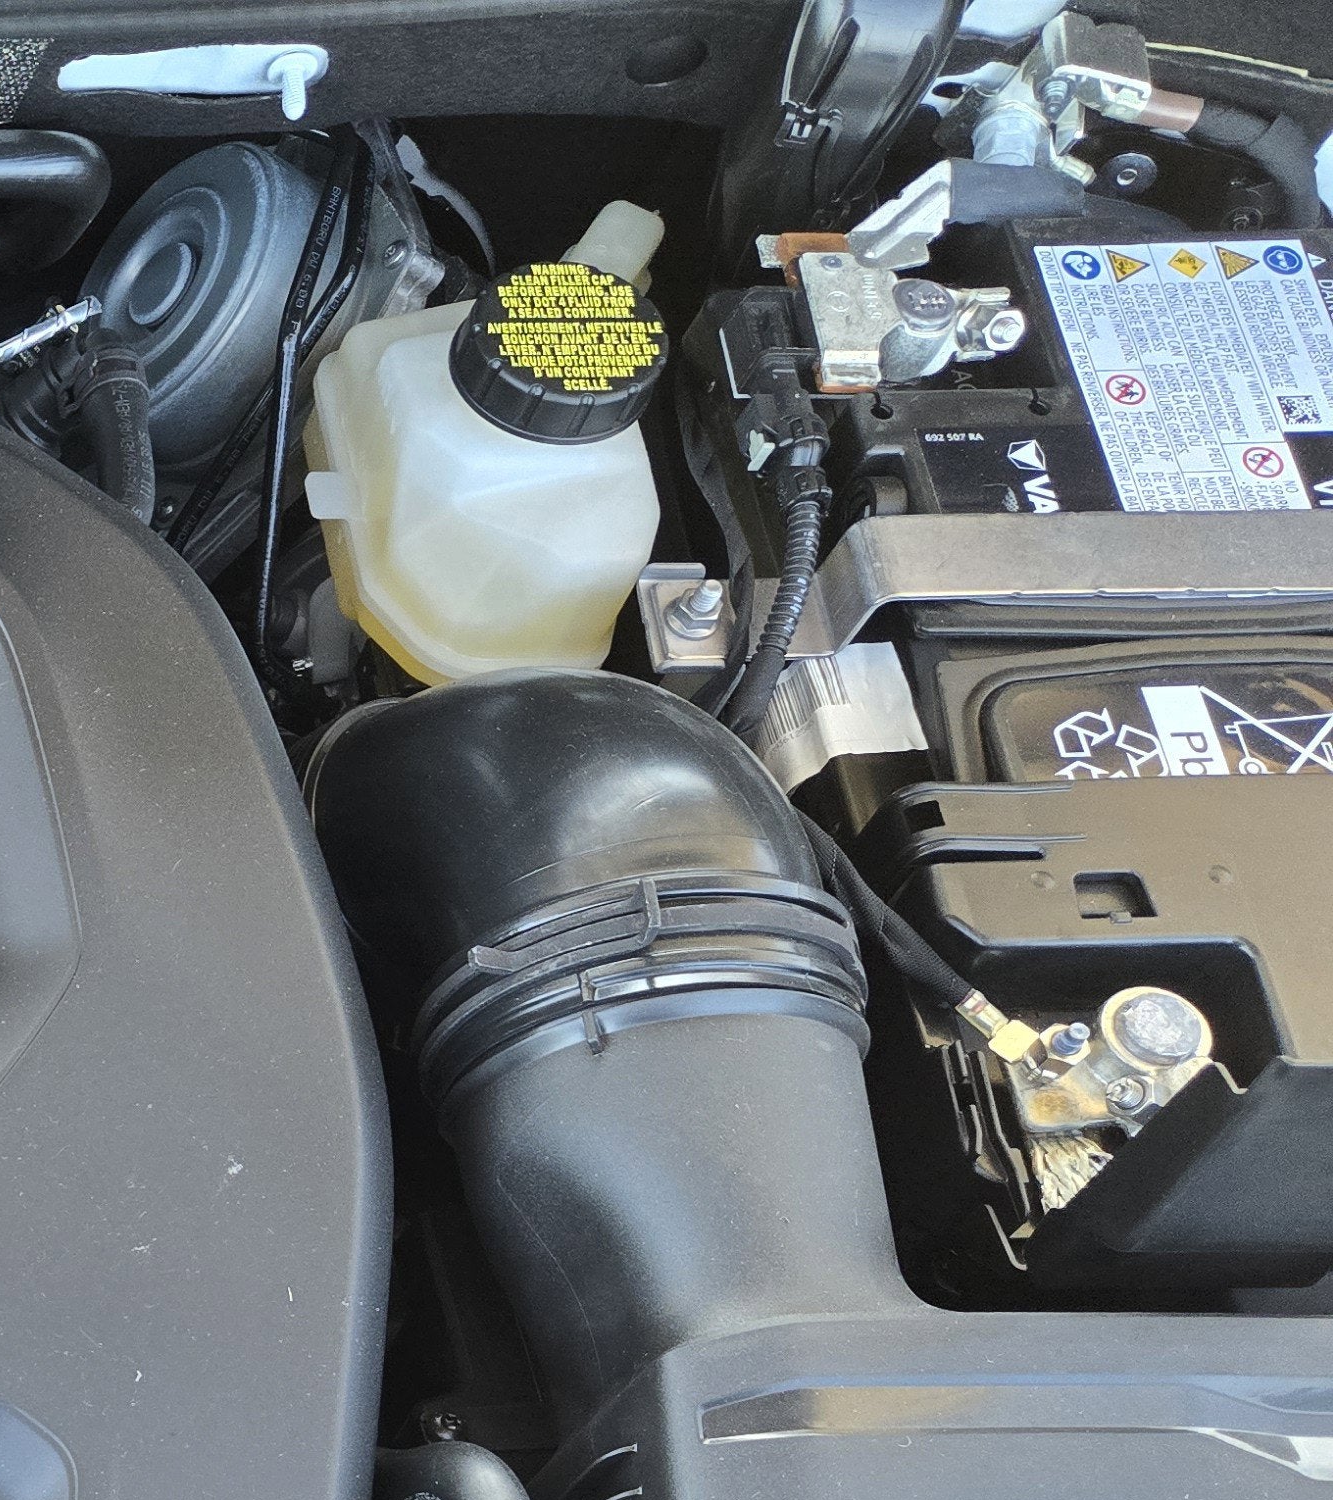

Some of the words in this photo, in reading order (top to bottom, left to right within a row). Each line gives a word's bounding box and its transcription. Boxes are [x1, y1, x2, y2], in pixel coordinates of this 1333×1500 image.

[1038, 251, 1056, 265] DO
[530, 264, 590, 275] WARNING:
[1043, 265, 1060, 280] NOT
[510, 275, 549, 286] CLEAN
[550, 275, 590, 286] FILLER
[591, 275, 615, 286] CAP
[1279, 280, 1297, 295] CAN
[497, 286, 543, 297] BEFORE
[609, 285, 634, 296] USE
[1049, 283, 1066, 296] TIP
[1083, 284, 1102, 303] LIRE
[1098, 284, 1117, 307] READ
[1115, 284, 1132, 297] OR
[1131, 284, 1151, 309] CAUSE
[1193, 282, 1210, 296] GET
[1207, 282, 1229, 305] FLUSH
[501, 297, 531, 308] ONLY
[533, 297, 557, 308] DOT
[558, 297, 567, 308] 4
[568, 297, 602, 308] FLUID
[603, 296, 635, 307] FROM
[1054, 295, 1070, 307] OR
[1145, 283, 1171, 320] SULFURIC
[508, 308, 516, 319] A
[518, 308, 562, 318] SEALED
[563, 307, 634, 318] CONTAINER.
[1090, 303, 1107, 317] LES
[1119, 297, 1143, 326] SEVERE
[1162, 283, 1191, 327] CONSULTEZ
[1180, 329, 1197, 341] UN
[1199, 297, 1223, 332] MEDICAL
[1217, 307, 1237, 326] EYES
[1286, 296, 1307, 322] CAUSE
[586, 322, 647, 334] NETTOYER
[646, 322, 663, 333] LE
[1139, 310, 1167, 353] BLINDNESS
[1159, 321, 1177, 339] ACID
[501, 334, 560, 345] BOUCHON
[562, 333, 598, 344] AVANT
[602, 333, 620, 344] DE
[1212, 333, 1230, 351] HELP
[499, 345, 541, 355] LEVER.
[616, 344, 641, 355] QUE
[643, 344, 660, 355] DU
[1069, 342, 1087, 354] NE
[1166, 341, 1184, 358] CAN
[510, 355, 556, 367] LIQUIDE
[587, 355, 653, 366] PROVENANT
[1074, 355, 1092, 370] PAS
[563, 366, 634, 377] CONTENANT
[1145, 365, 1161, 381] DES
[1247, 381, 1265, 401] WITH
[1158, 364, 1181, 394] CAUSER
[1171, 395, 1186, 406] LA
[1186, 435, 1202, 447] OU
[1113, 411, 1130, 424] OF
[1129, 412, 1146, 428] THE
[1143, 411, 1163, 432] KEEP
[1134, 429, 1156, 455] REACH
[1152, 433, 1170, 450] OUT
[1158, 451, 1173, 463] OF
[1206, 448, 1226, 469] PEUT
[1135, 472, 1153, 488] DES
[1151, 472, 1166, 483] DE
[1167, 472, 1186, 496] TENIR
[1156, 486, 1172, 496] LA
[1202, 476, 1220, 499] MUST
[1212, 500, 1225, 509] BE
[1283, 480, 1298, 494] NO
